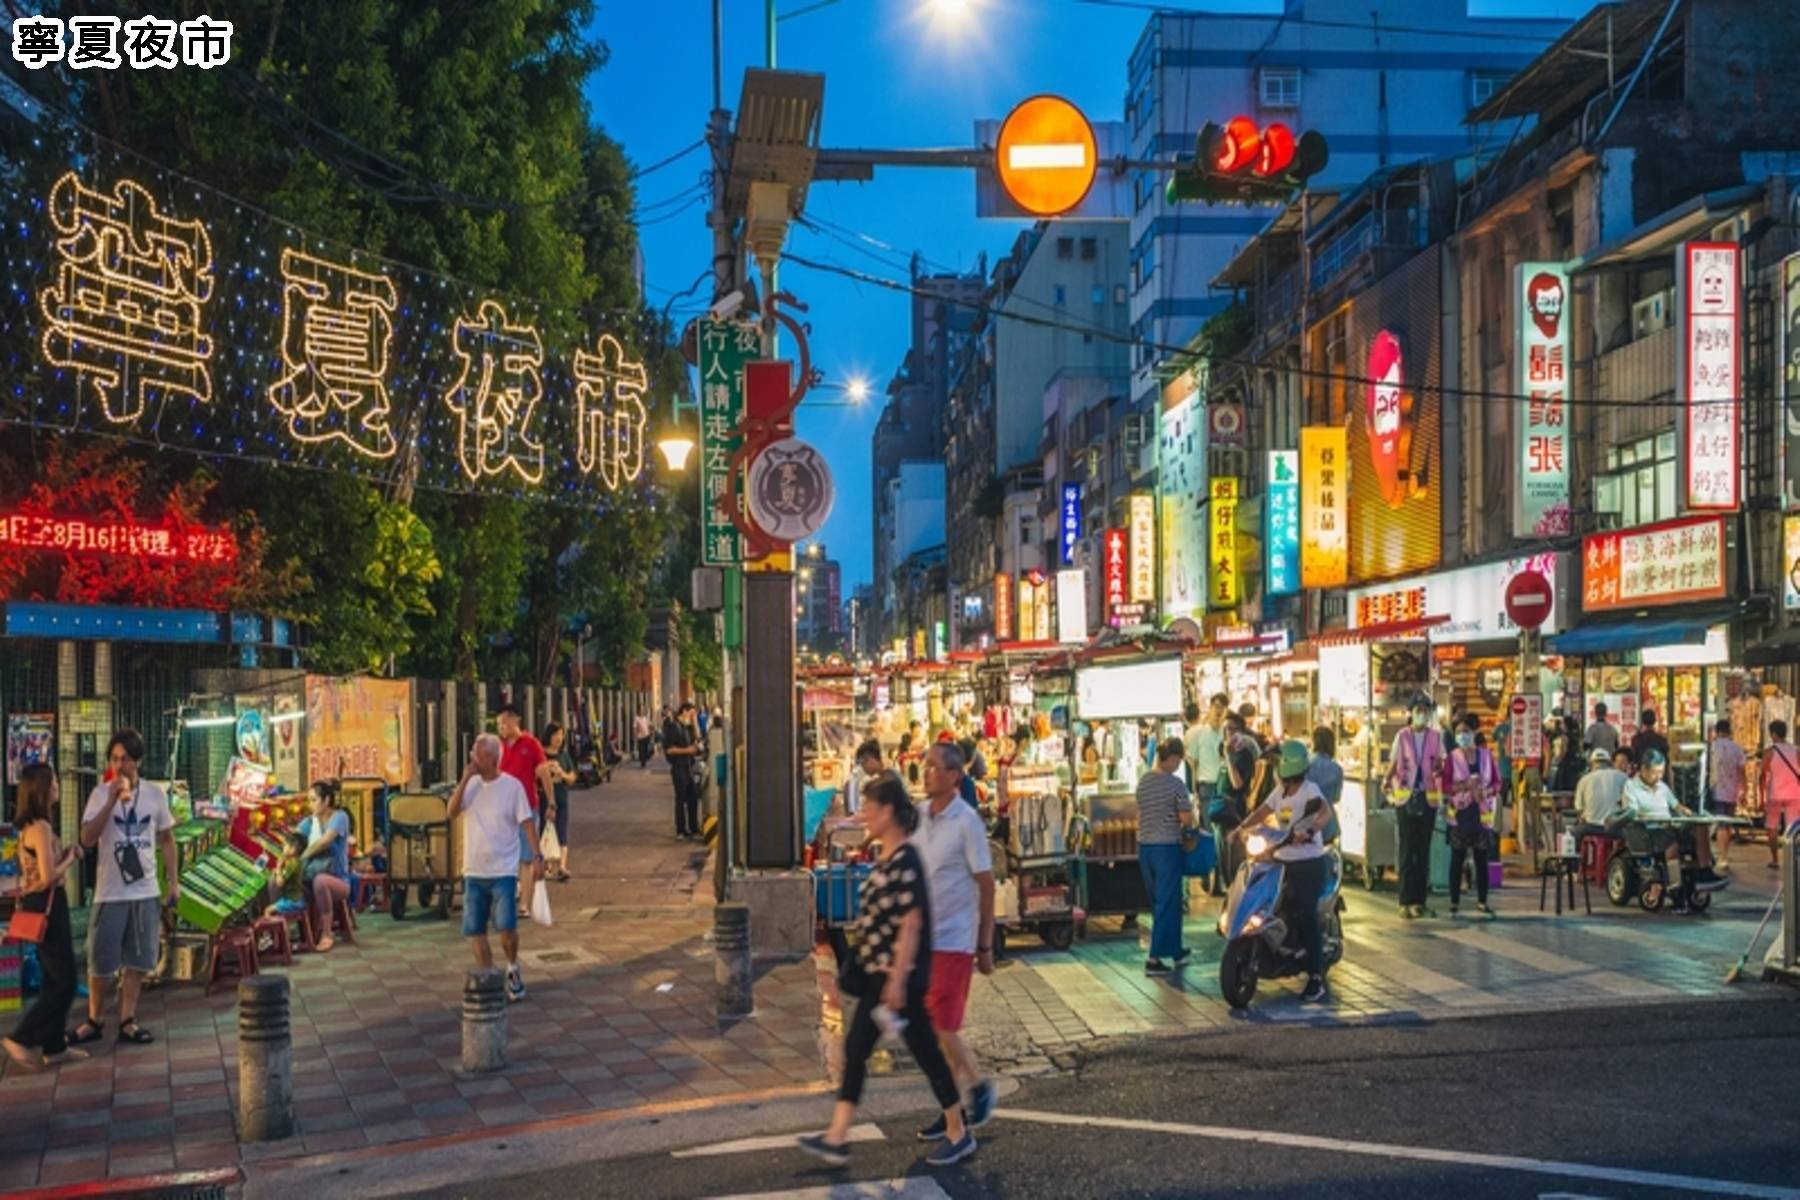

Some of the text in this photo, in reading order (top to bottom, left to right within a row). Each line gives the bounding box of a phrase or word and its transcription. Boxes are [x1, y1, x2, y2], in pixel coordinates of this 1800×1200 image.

[41, 171, 649, 490] 寧夏夜市
[1529, 344, 1564, 473] 鬍鬚張
